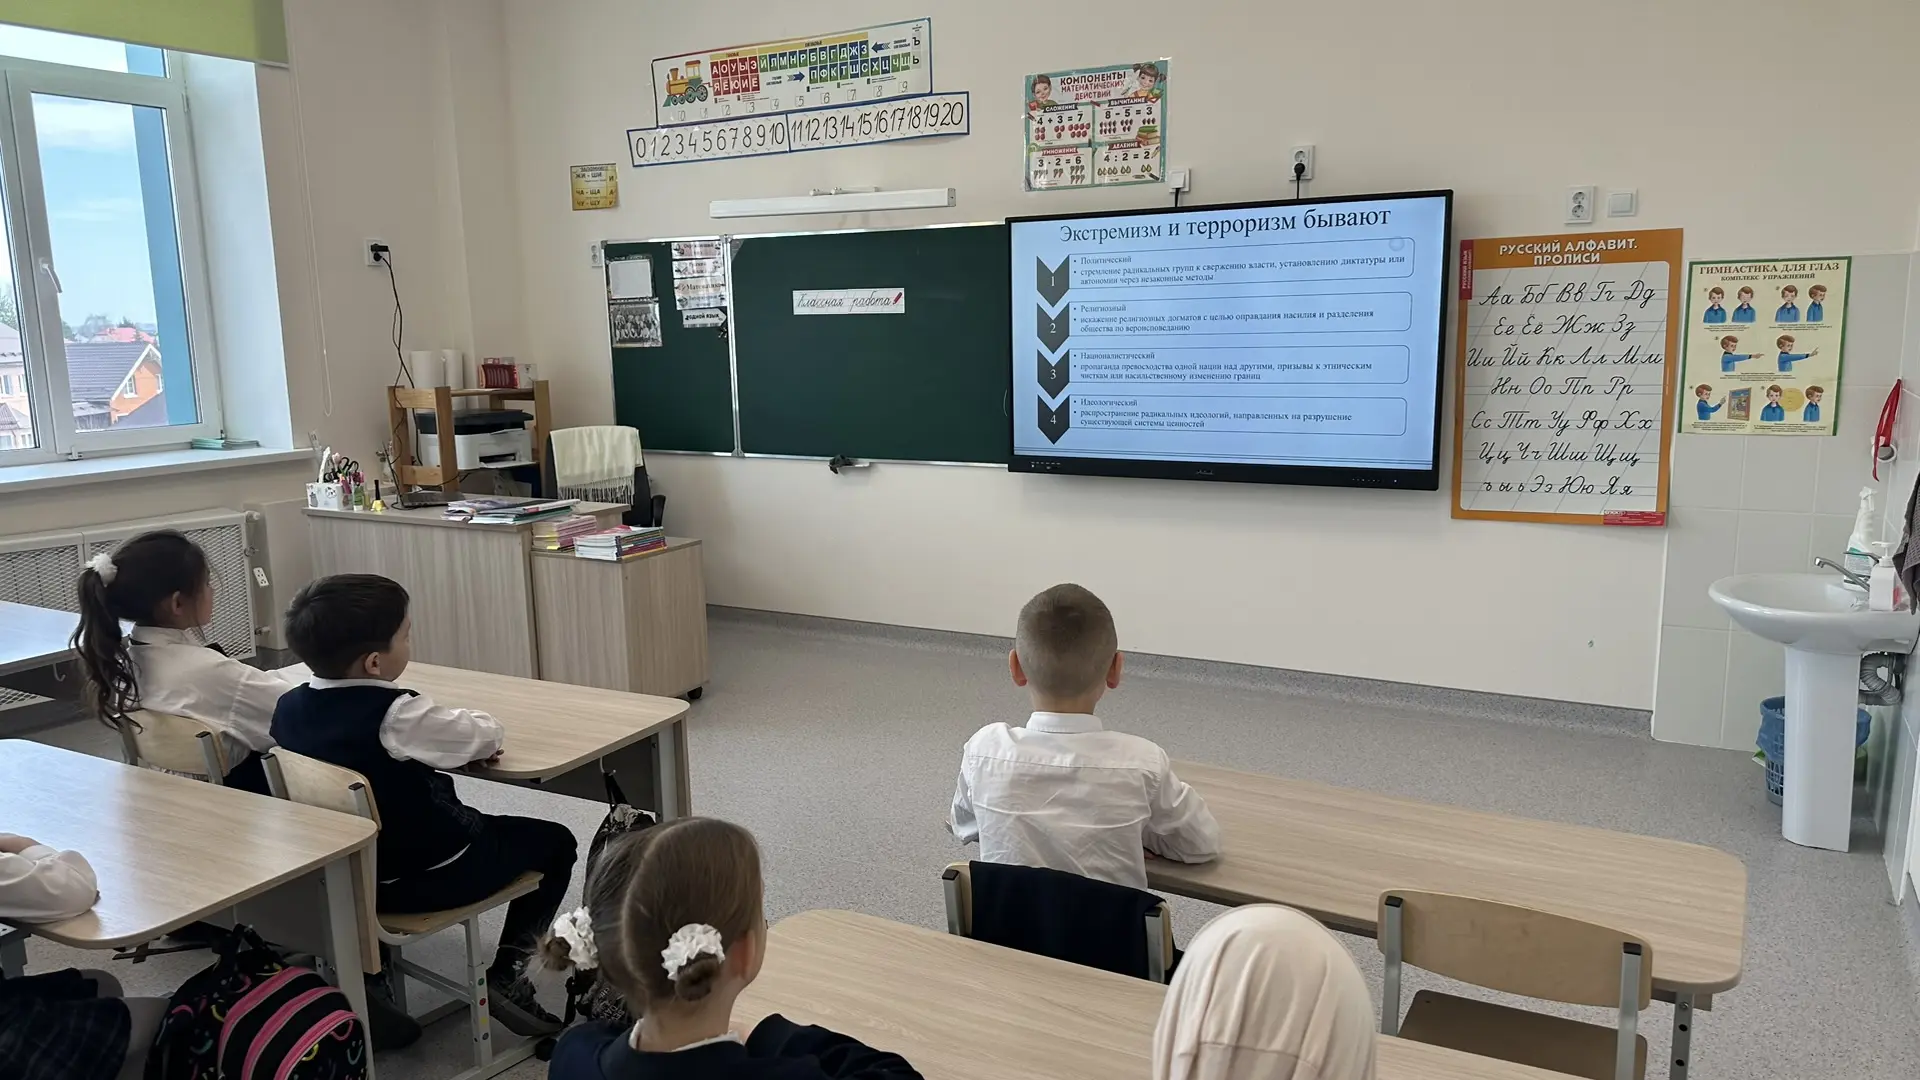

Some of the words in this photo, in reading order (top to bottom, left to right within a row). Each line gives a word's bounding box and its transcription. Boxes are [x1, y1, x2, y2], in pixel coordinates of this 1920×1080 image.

[1060, 71, 1126, 85] КОМПОНЕНТЫ
[1061, 80, 1125, 93] МАТЕМАТИЧЕСКИХ
[1075, 91, 1111, 101] ДЕЙСТВИЙ
[1110, 98, 1145, 106] ВЫЧИТАНИЕ
[1046, 104, 1076, 112] СЛОЖЕНИЕ
[1105, 111, 1111, 119] 8
[1125, 108, 1130, 117] 5
[1146, 107, 1152, 115] 3
[1037, 117, 1043, 125] 4
[1057, 115, 1063, 123] 3
[1078, 113, 1083, 122] 7
[636, 138, 646, 158] 0
[650, 137, 656, 157] 1
[661, 136, 671, 156] 2
[675, 134, 685, 154] 3
[688, 133, 698, 153] 4
[703, 131, 713, 152] 5
[716, 130, 727, 150] 6
[729, 128, 738, 149] 7
[742, 127, 752, 148] 8
[756, 126, 766, 146] 9
[770, 123, 785, 145] 10
[791, 121, 804, 142] 11
[805, 119, 820, 141] 12
[823, 117, 838, 139] 13
[840, 115, 855, 137] 14
[857, 114, 872, 136] 15
[873, 111, 888, 132] 16
[890, 110, 905, 131] 17
[906, 108, 922, 130] 18
[923, 105, 939, 127] 19
[940, 102, 964, 125] 20
[1038, 159, 1044, 167] 3
[1075, 156, 1081, 164] 6
[1104, 154, 1110, 162] 4
[1122, 153, 1128, 161] 2
[1144, 151, 1149, 159] 2
[1060, 224, 1161, 244] Экстремизм
[1168, 223, 1180, 236] и
[1186, 215, 1296, 240] терроризм
[1304, 208, 1391, 228] бывают
[1500, 239, 1560, 255] РУССКИЙ
[1565, 238, 1637, 252] АЛФАВИТ.
[1534, 253, 1600, 266] ПРОПИСИ
[1699, 264, 1778, 275] ГИМНАСТИКА
[1781, 263, 1806, 273] ДЛЯ
[1809, 262, 1839, 271] ГЛАЗ
[1050, 276, 1055, 287] 1
[1763, 273, 1815, 281] УПРАЖНЕНИЙ
[797, 293, 844, 308] Классная
[849, 290, 892, 312] работа
[1050, 323, 1056, 334] 2
[1050, 369, 1056, 380] 3
[1050, 414, 1056, 425] 4
